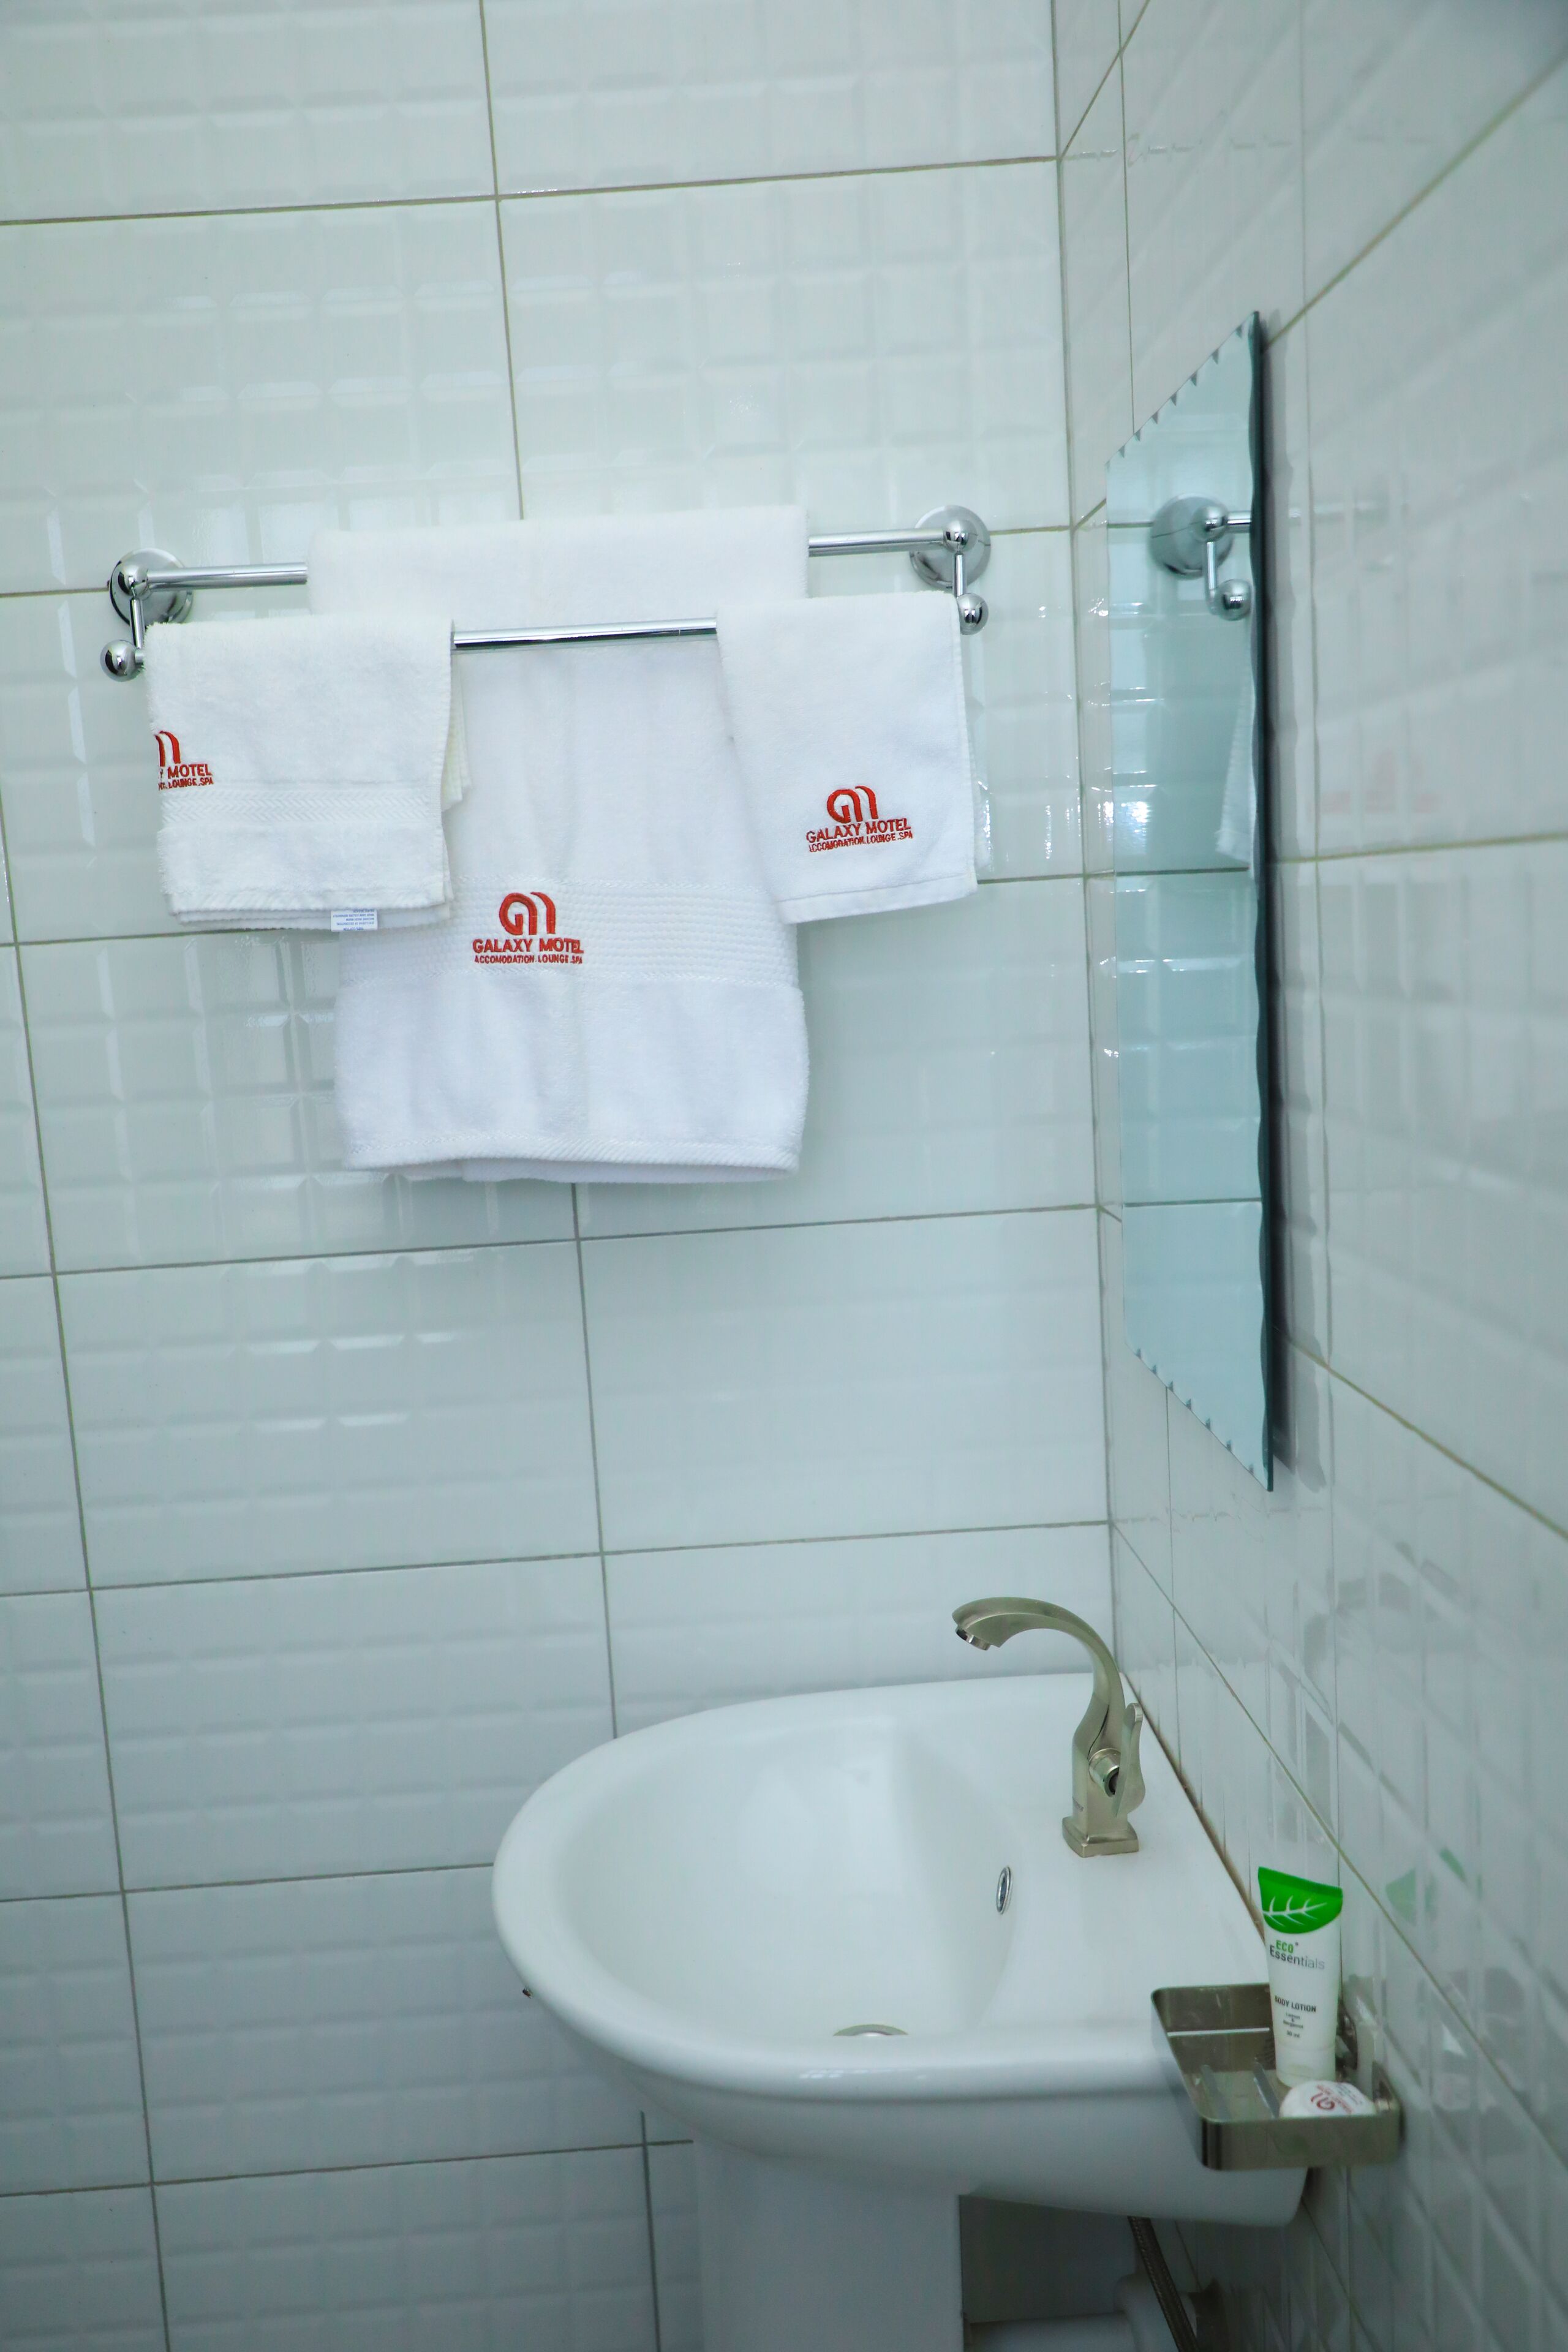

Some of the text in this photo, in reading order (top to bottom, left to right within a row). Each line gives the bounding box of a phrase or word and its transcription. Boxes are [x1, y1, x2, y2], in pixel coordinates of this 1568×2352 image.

[167, 764, 213, 779] MOTEL
[806, 818, 911, 843] GALAXY MOTEL
[472, 937, 584, 954] GALAXY MOTEL
[1270, 1945, 1325, 1970] Essentials
[1275, 1995, 1316, 2013] BODY LOTION
